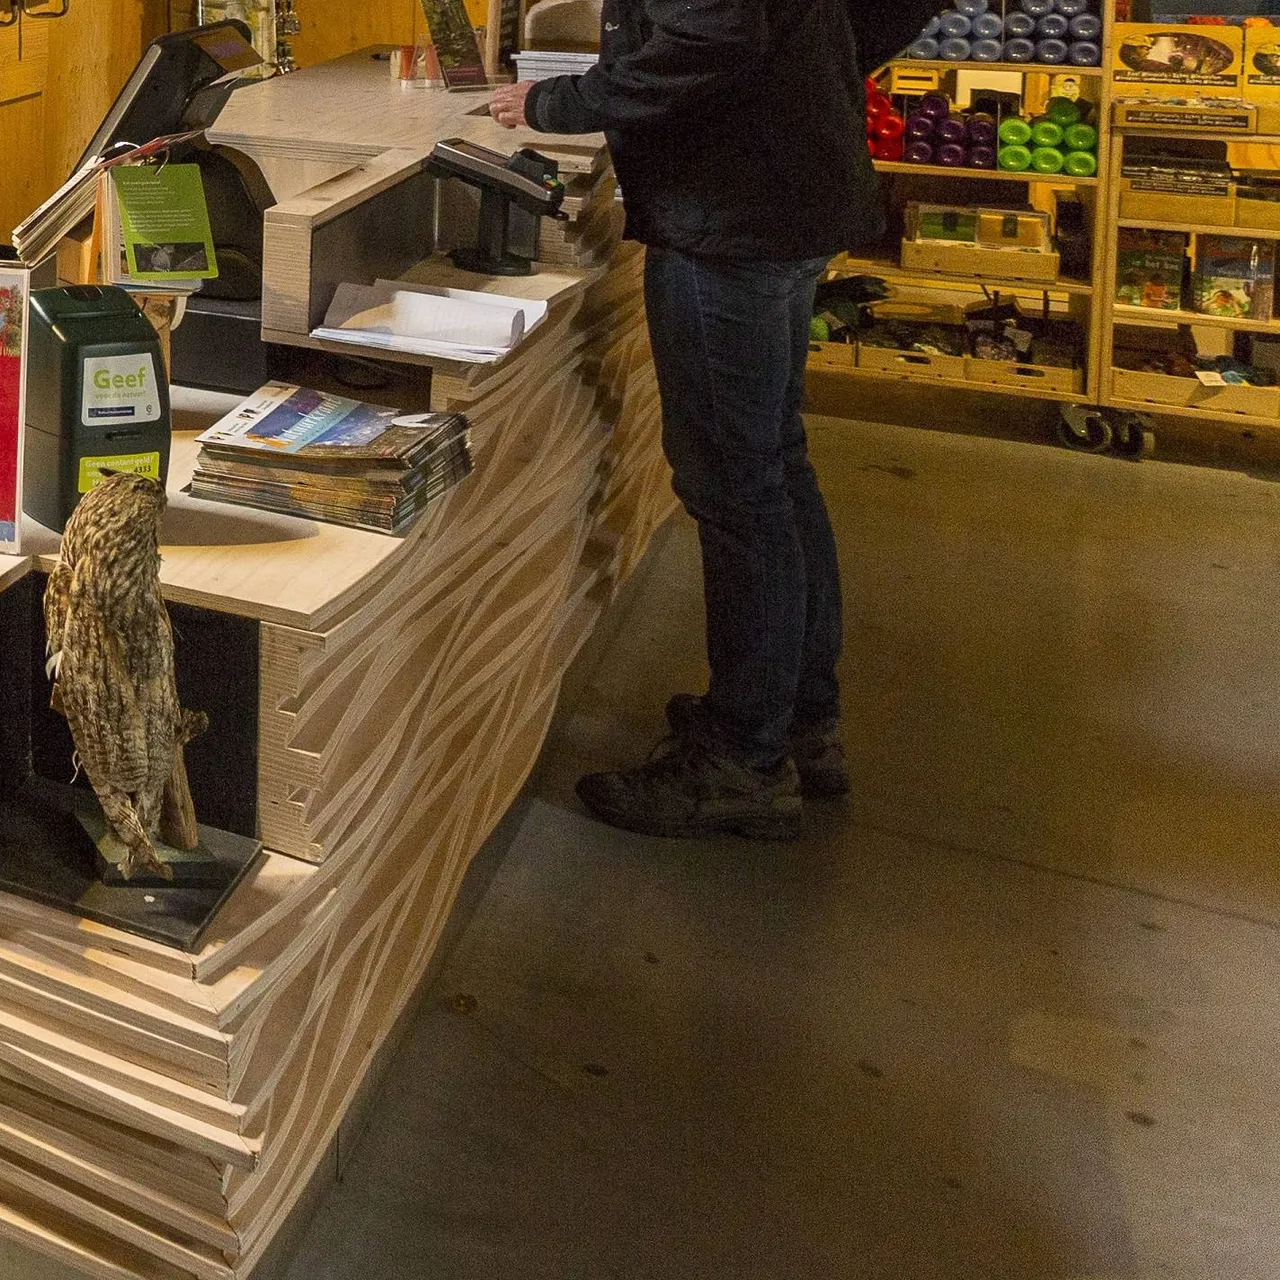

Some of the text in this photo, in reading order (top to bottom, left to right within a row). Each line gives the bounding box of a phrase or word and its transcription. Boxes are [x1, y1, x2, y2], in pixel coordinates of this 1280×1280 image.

[93, 365, 148, 390] Geef
[85, 459, 106, 469] Geen
[106, 456, 134, 468] contant
